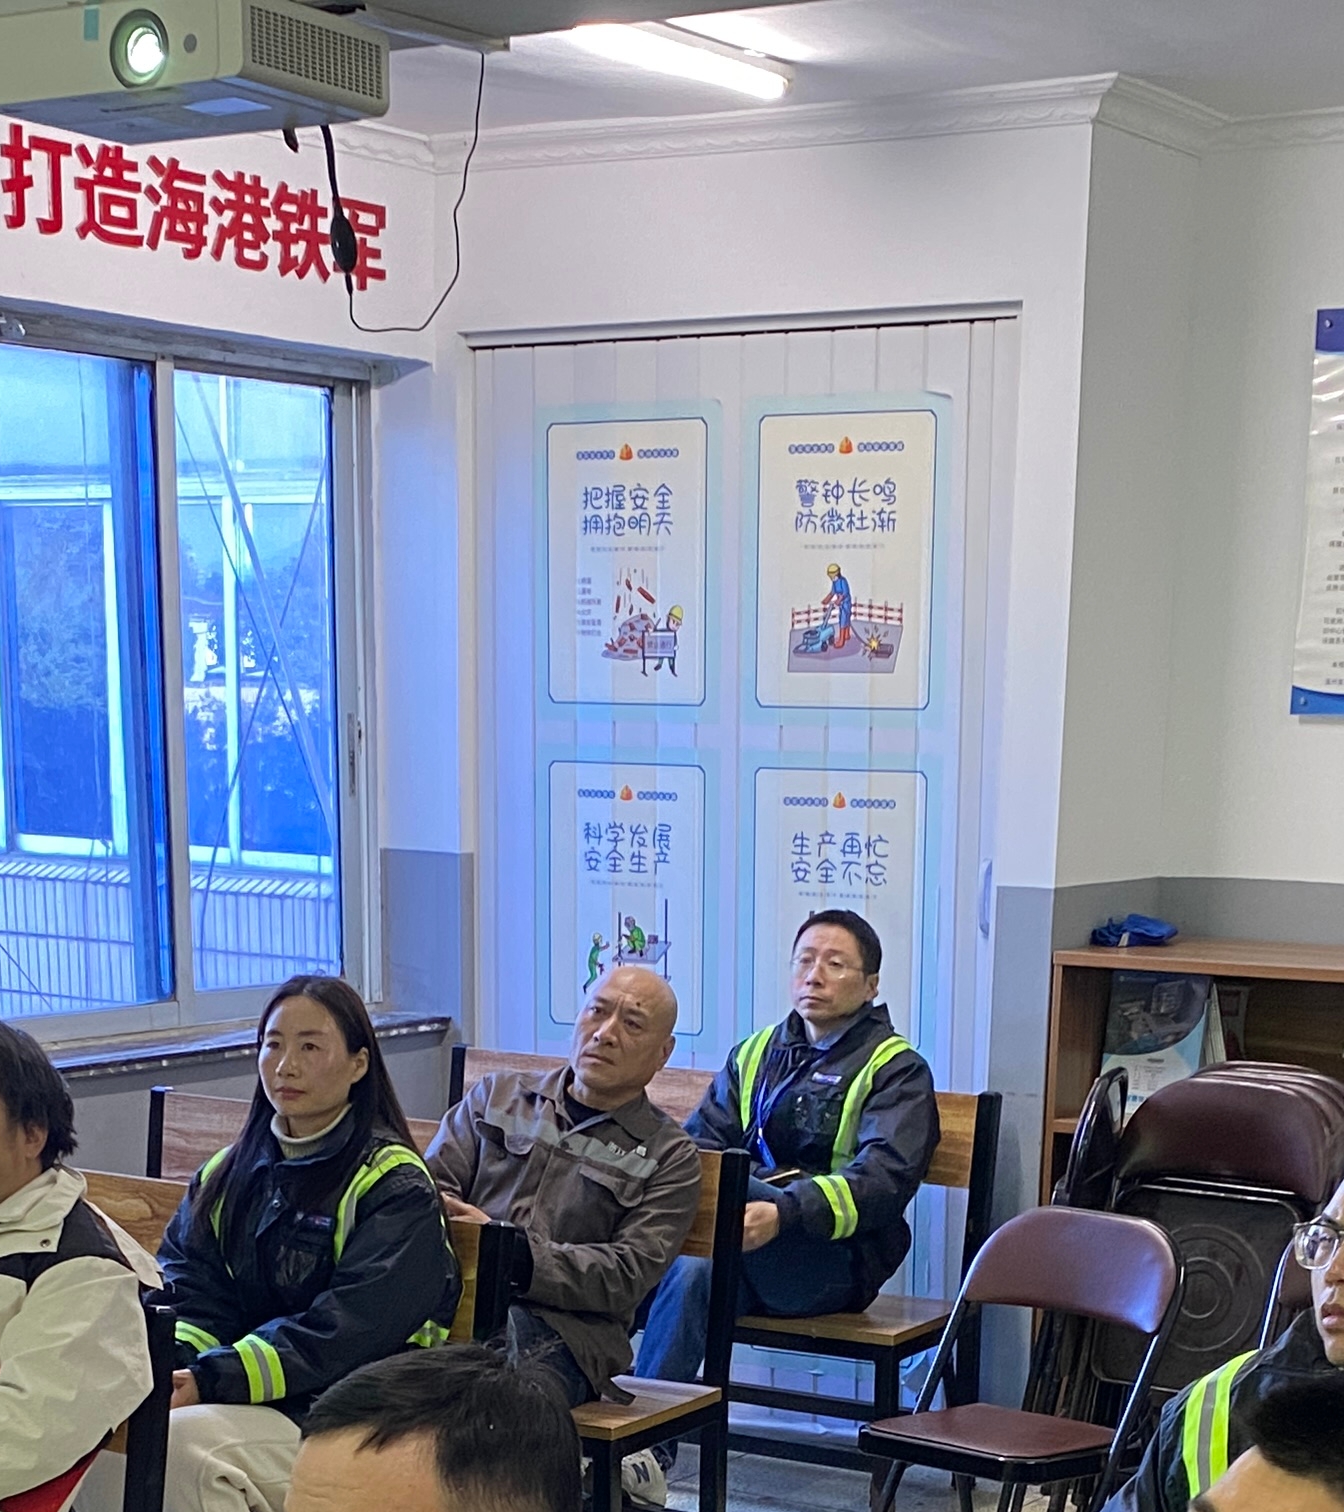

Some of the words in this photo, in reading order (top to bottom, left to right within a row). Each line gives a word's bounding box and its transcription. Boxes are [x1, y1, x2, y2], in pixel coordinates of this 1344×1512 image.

[0, 122, 387, 291] 打造海港铁军
[582, 483, 674, 512] 把握安全
[795, 477, 897, 508] 警钟长鸣
[581, 511, 674, 537] 拥抱明天
[794, 508, 897, 535] 防微杜渐
[583, 821, 673, 850] 科学发展
[790, 829, 890, 860] 生产再忙
[584, 848, 671, 876] 安全生产
[790, 859, 888, 887] 安全不忘
